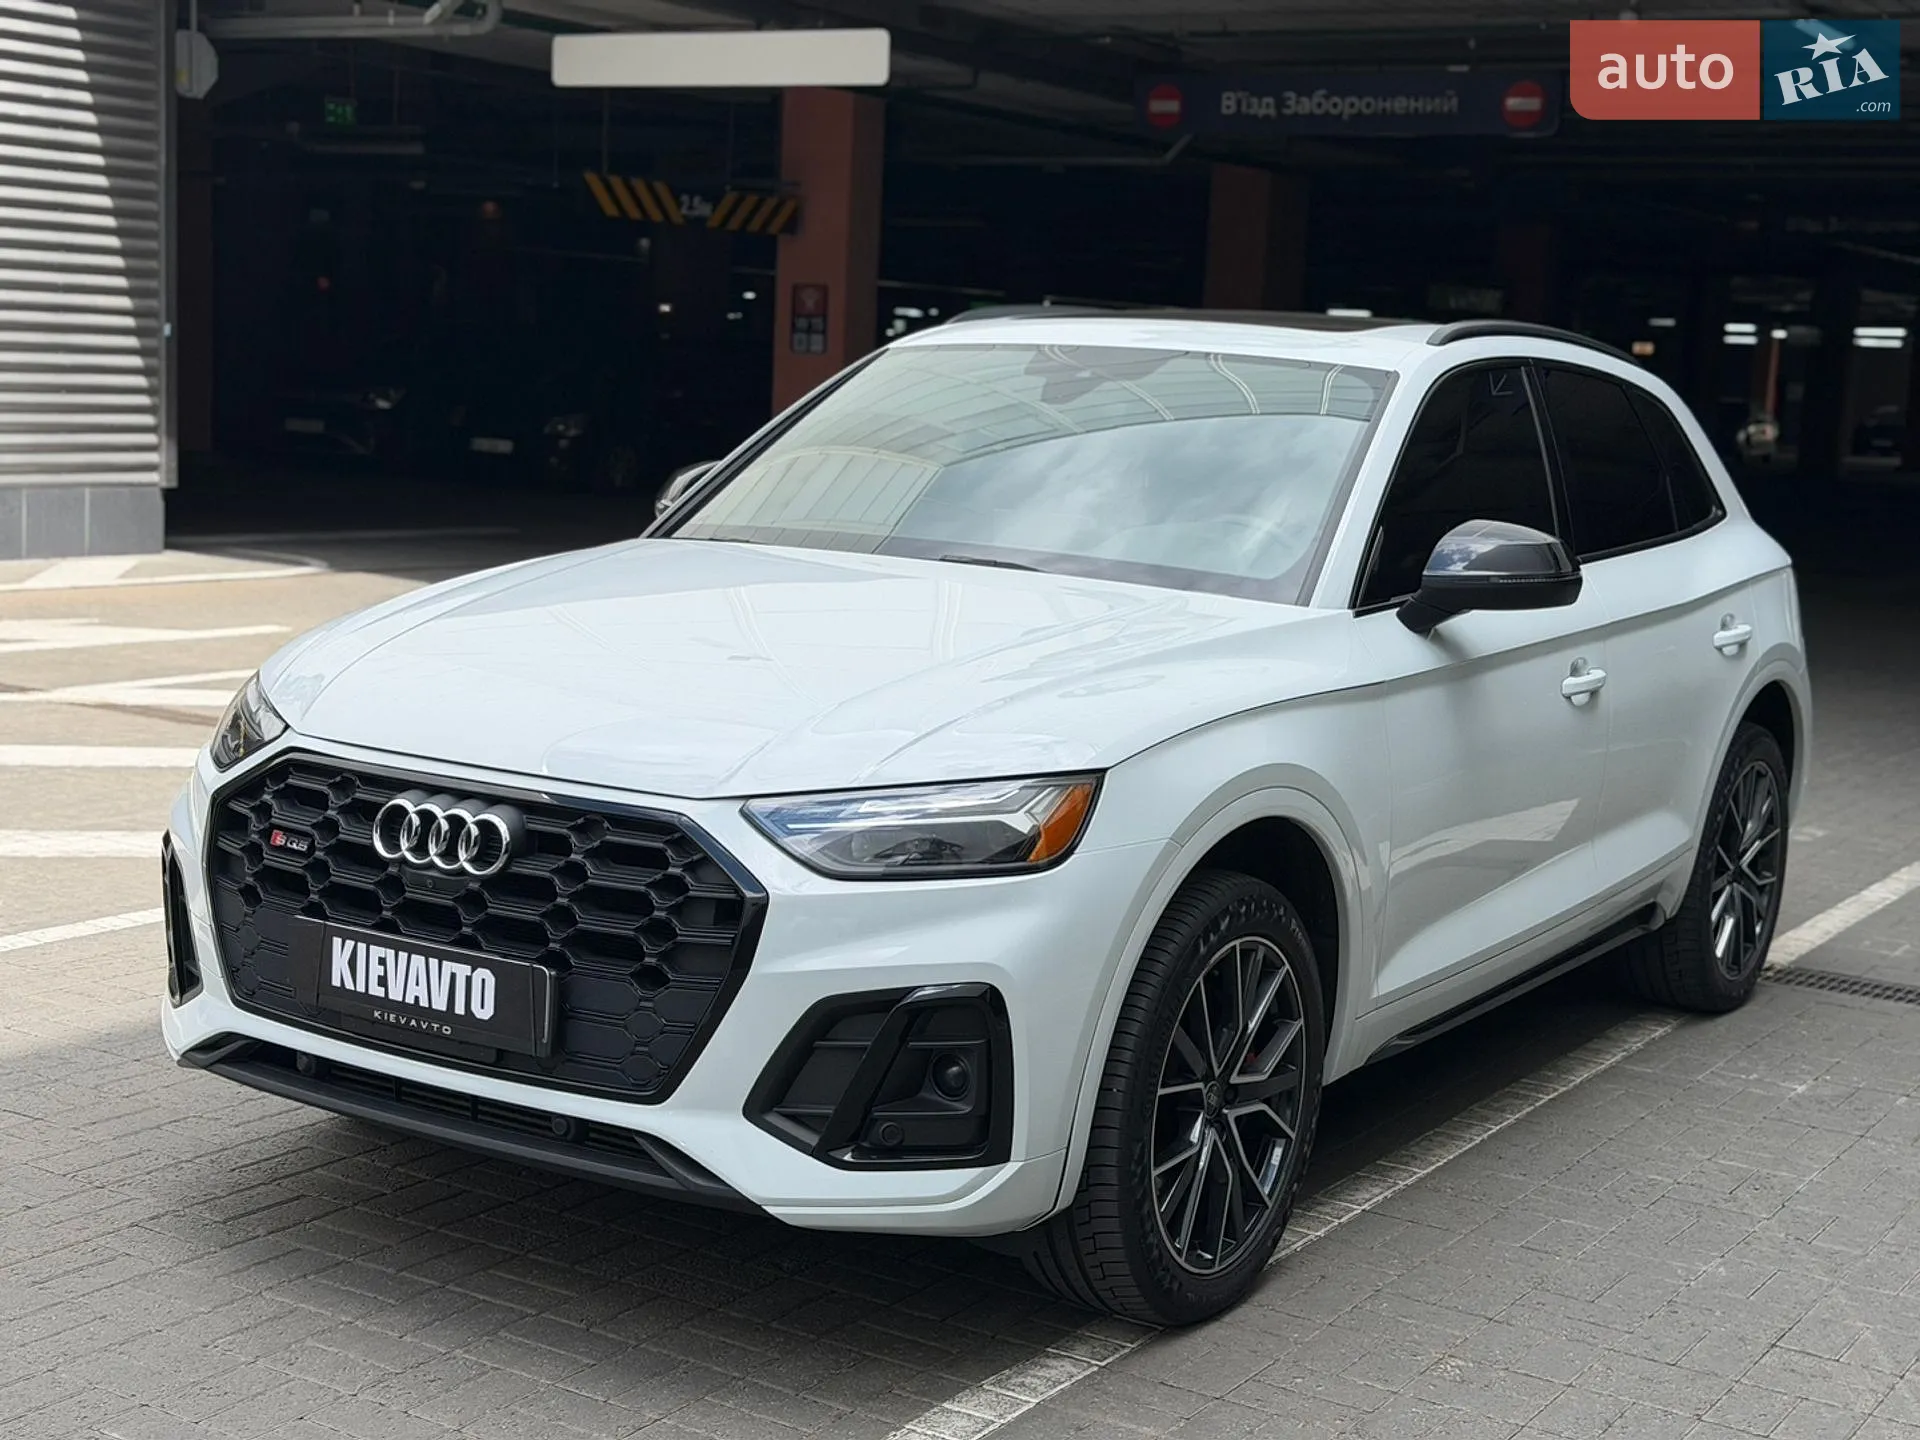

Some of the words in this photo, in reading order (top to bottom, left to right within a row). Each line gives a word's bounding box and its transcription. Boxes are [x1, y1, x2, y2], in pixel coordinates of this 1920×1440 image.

[1281, 90, 1458, 119] Заборонений
[331, 936, 496, 1020] KIEVAVTO
[373, 1010, 452, 1035] KIEVAVTO
